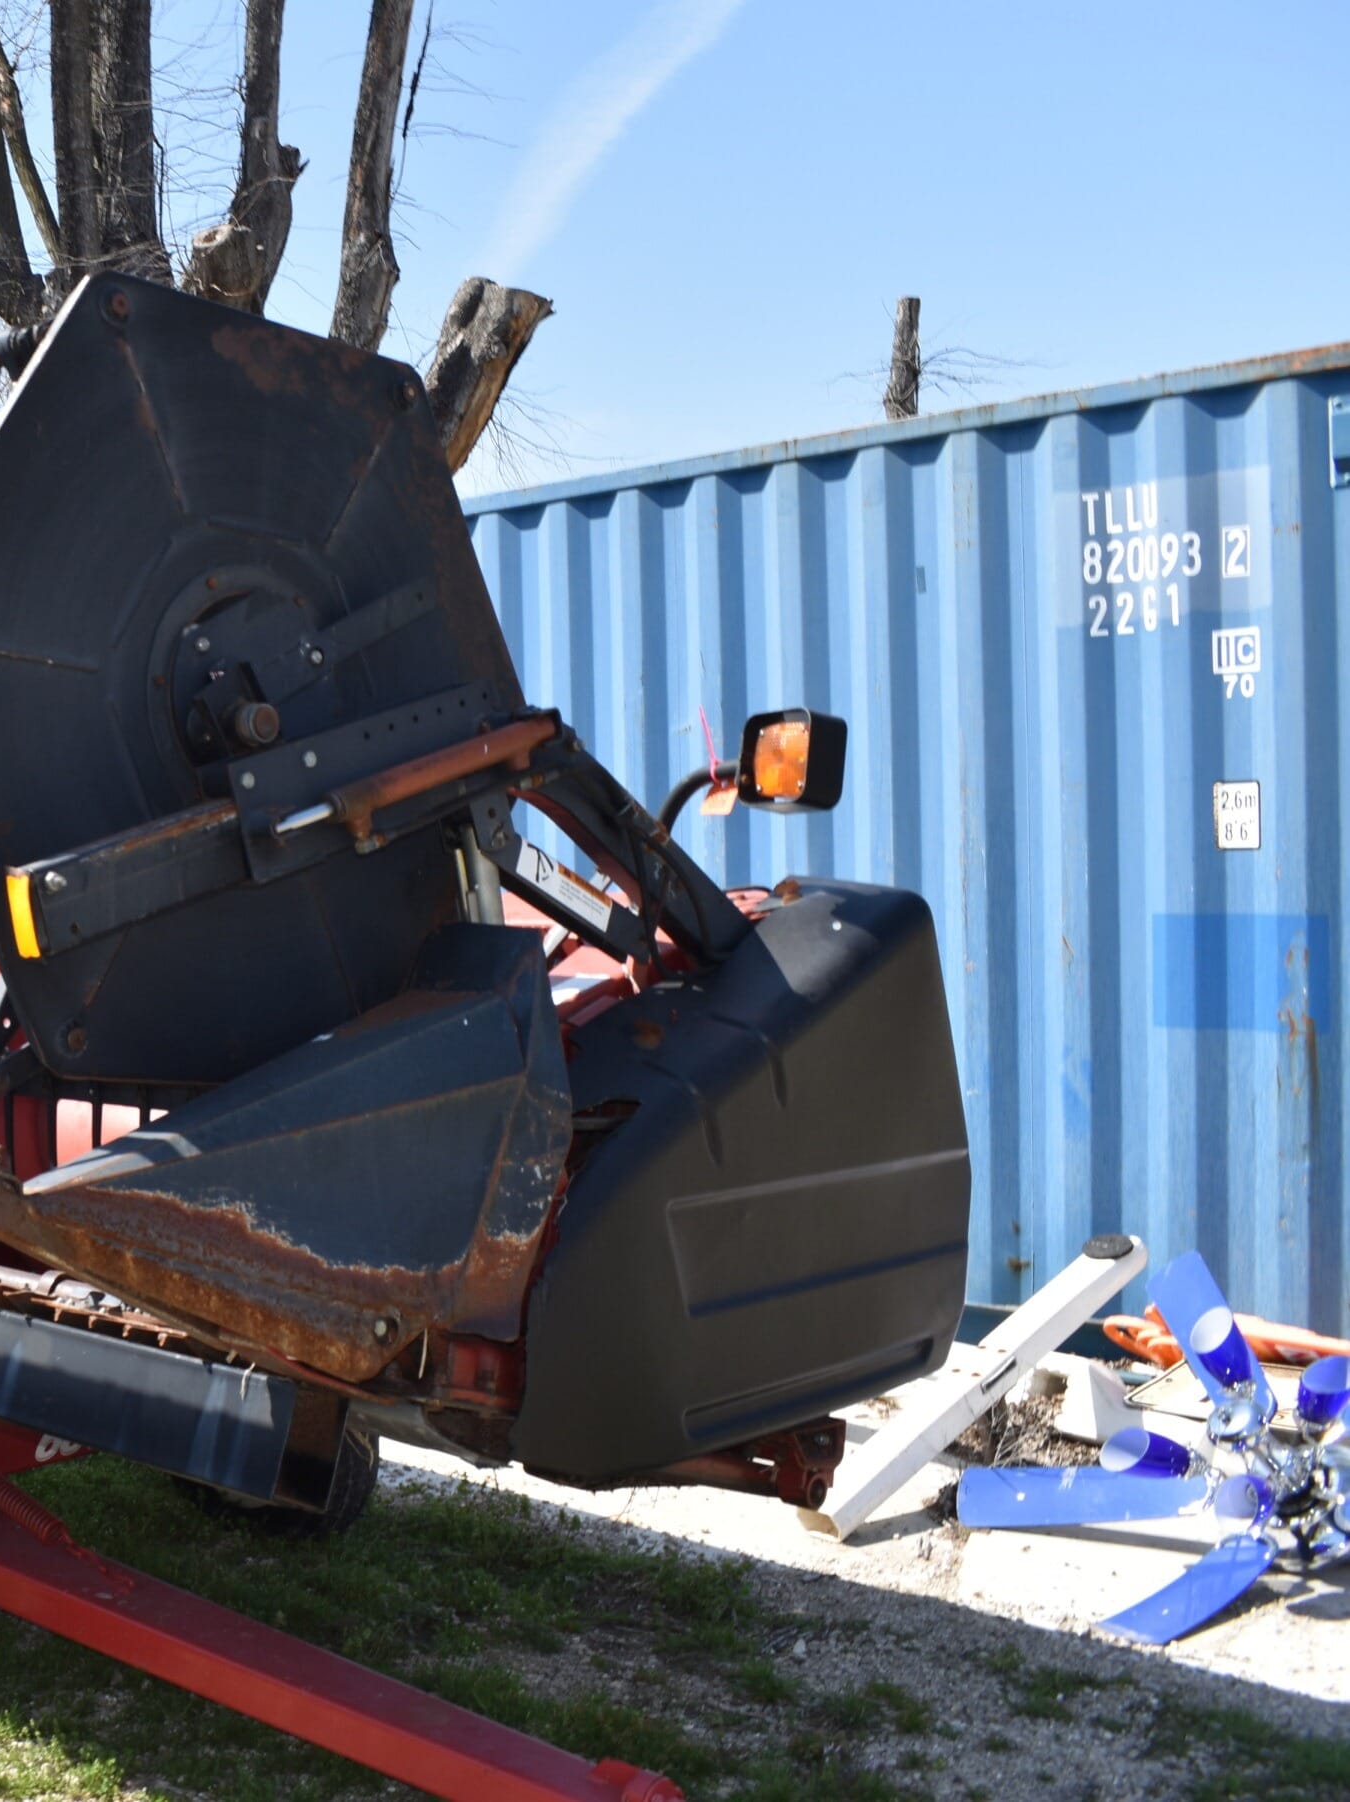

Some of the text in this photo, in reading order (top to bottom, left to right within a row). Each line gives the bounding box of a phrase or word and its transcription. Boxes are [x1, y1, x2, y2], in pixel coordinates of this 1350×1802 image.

[1081, 481, 1158, 536] TLLU
[1082, 526, 1249, 584] 820093 2
[1223, 673, 1255, 699] 70
